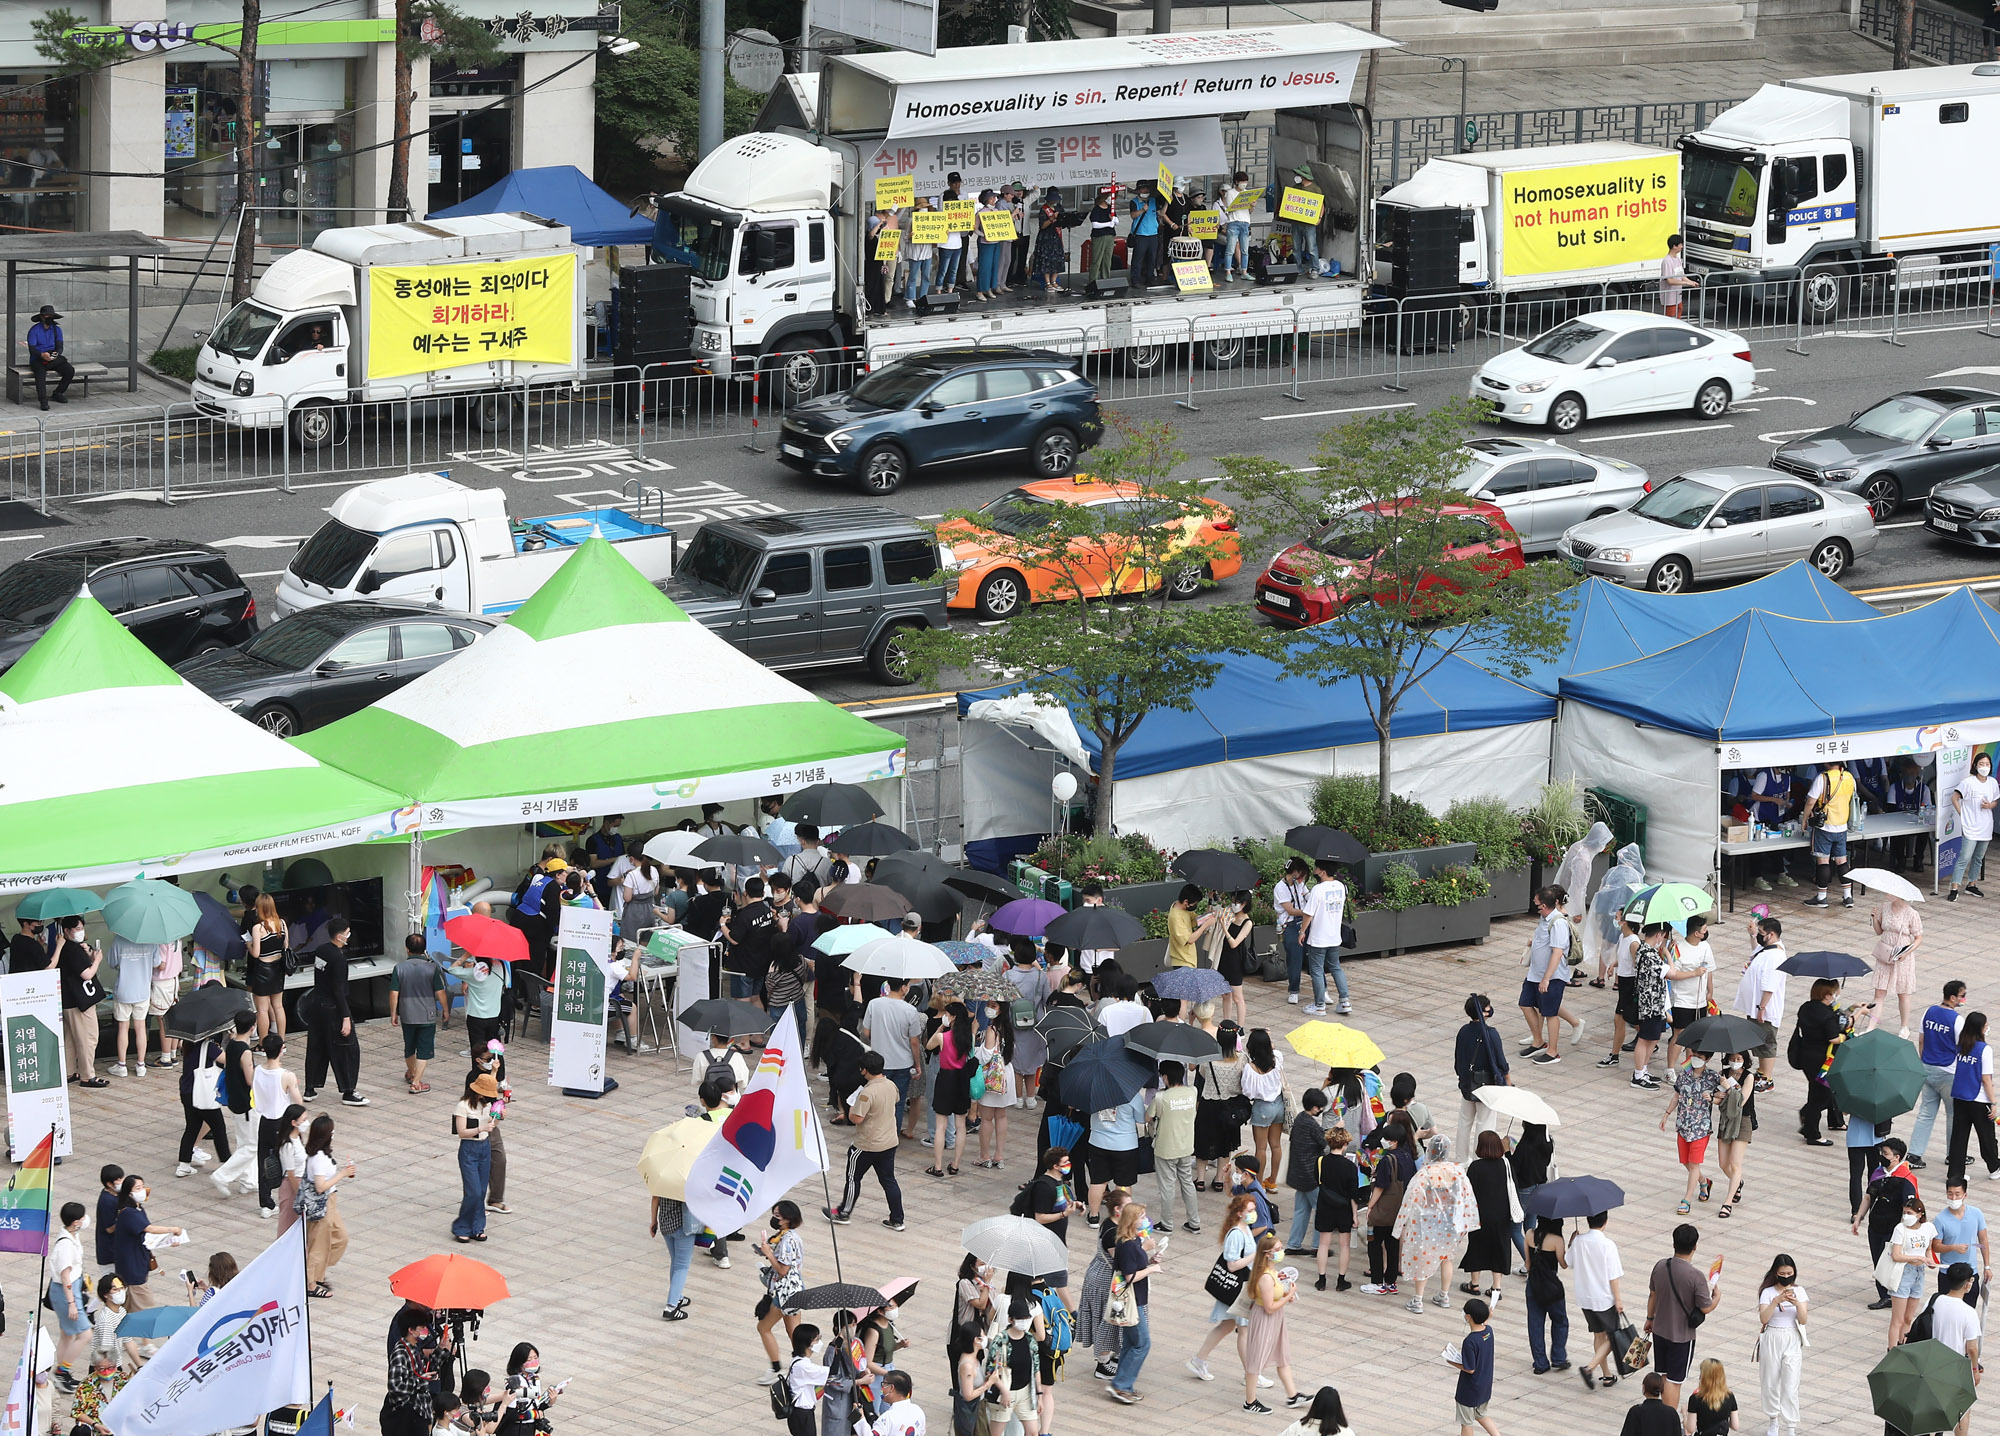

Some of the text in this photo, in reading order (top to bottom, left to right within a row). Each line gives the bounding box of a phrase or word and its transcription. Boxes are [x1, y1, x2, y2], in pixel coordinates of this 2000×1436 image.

[130, 21, 187, 52] CU
[906, 71, 1340, 118] Homosexuality is sin. Repent! Return to Jesus.
[1514, 173, 1667, 204] Homosexuality is
[892, 195, 907, 205] SIN
[1514, 197, 1667, 228] not human rights
[1788, 211, 1818, 222] POLICE
[1558, 226, 1626, 248] but sin.
[394, 269, 549, 299] 동성애는 죄악이다
[431, 301, 515, 325] 회개하라!
[413, 327, 528, 354] 예수는 구세주
[1816, 741, 1850, 755] 의무실
[771, 767, 826, 787] 공식 기념품
[521, 797, 579, 814] 공식 기념품
[223, 827, 362, 857] KOREA QUEER FILM FESTIVAL, KQFF
[1020, 878, 1034, 891] 2022
[567, 960, 587, 974] 치열
[566, 974, 586, 987] 하게
[82, 980, 95, 997] C
[565, 988, 585, 1001] 퀴어
[564, 1002, 584, 1015] 하라
[15, 1027, 36, 1040] 치열
[1925, 1020, 1950, 1034] STAFF
[16, 1042, 38, 1055] 하게
[17, 1056, 38, 1070] 퀴어
[17, 1070, 40, 1084] 하라
[1226, 1271, 1238, 1280] you
